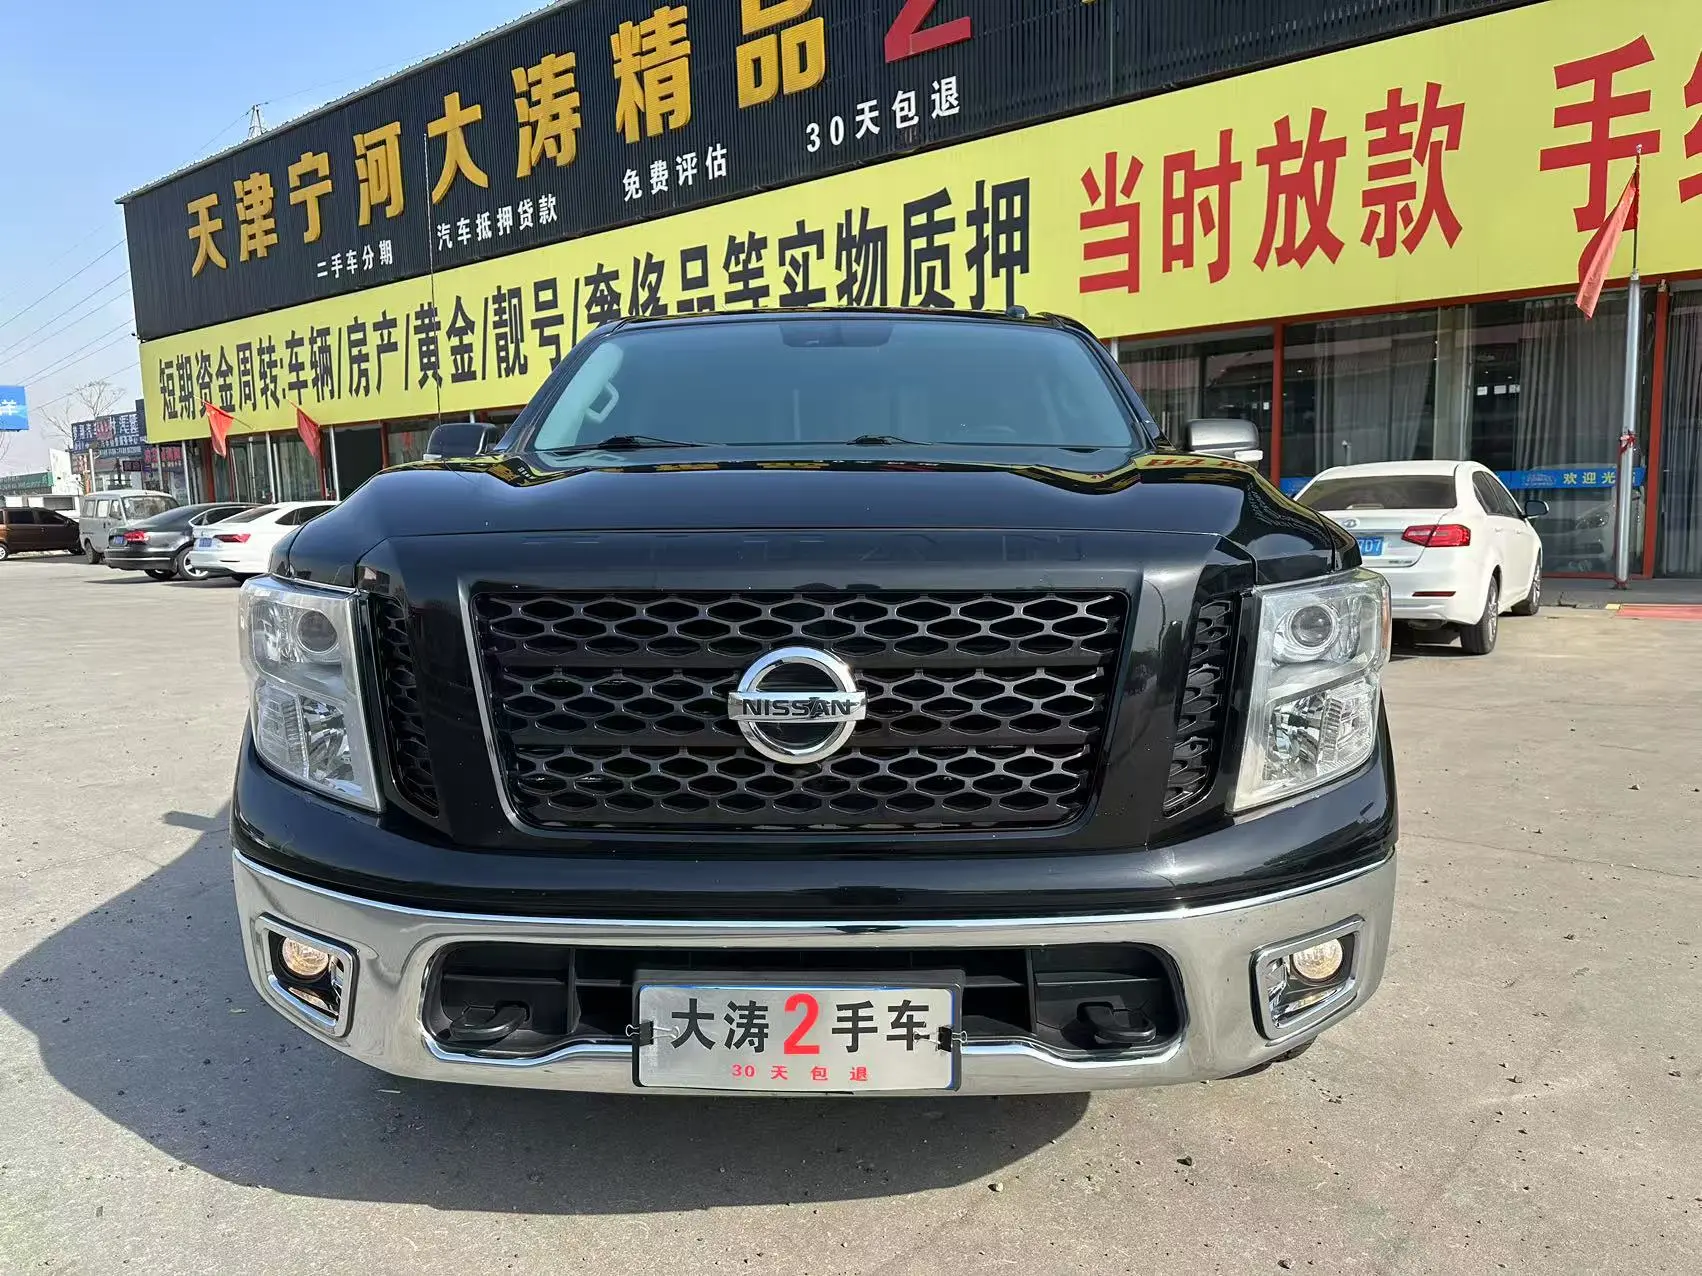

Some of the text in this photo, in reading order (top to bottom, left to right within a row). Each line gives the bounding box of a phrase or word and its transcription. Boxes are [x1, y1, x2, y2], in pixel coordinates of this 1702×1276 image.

[806, 76, 960, 153] 30天包退
[622, 144, 728, 202] 免费评估
[1079, 81, 1466, 294] 当时放款
[1540, 34, 1702, 232] 手
[436, 194, 557, 251] 汽车抵押贷款
[316, 240, 393, 279] 二手车分期
[1563, 471, 1635, 485] 欢迎光
[742, 698, 851, 716] NISSAN
[670, 992, 930, 1056] 大涛2手车
[732, 1064, 868, 1082] 30天包退
